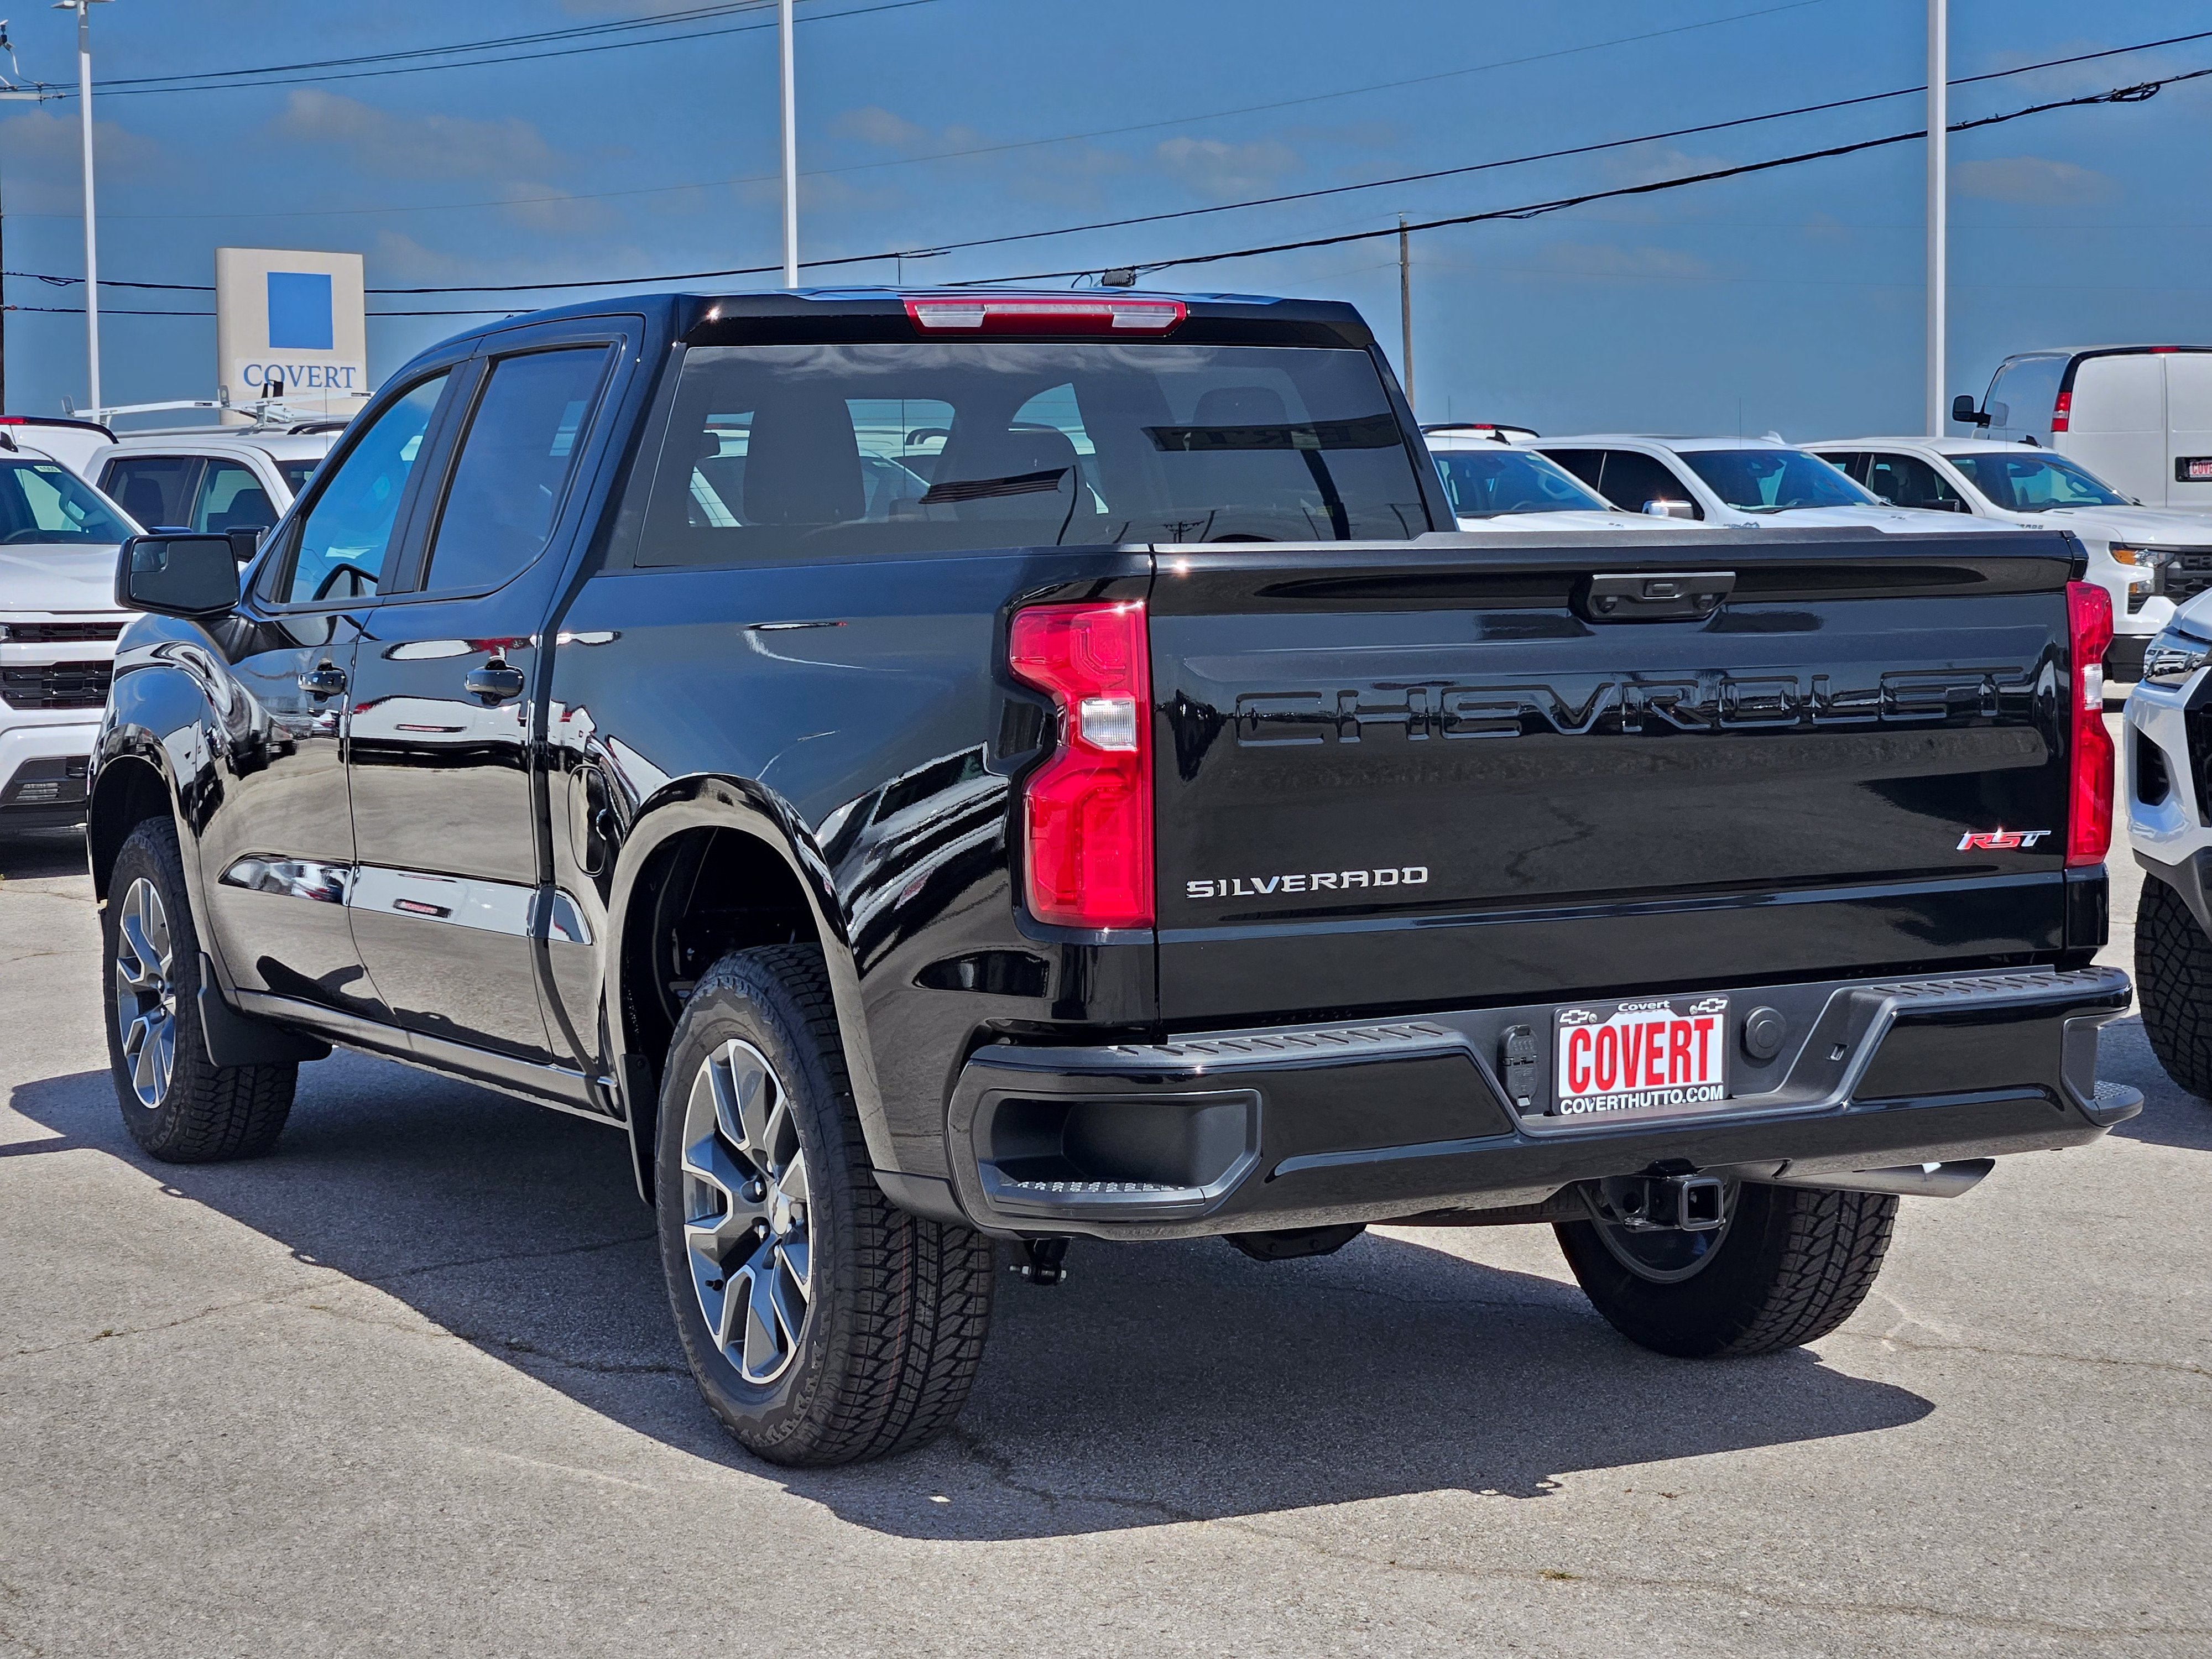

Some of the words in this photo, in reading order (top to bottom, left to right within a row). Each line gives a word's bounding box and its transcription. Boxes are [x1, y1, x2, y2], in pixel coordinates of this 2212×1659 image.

[243, 364, 356, 388] COVERT
[1236, 667, 2024, 747] CHEVROLET
[1956, 830, 2051, 849] RST
[1186, 867, 1428, 898] SILVERADO
[1618, 1000, 1670, 1011] Covert
[1568, 1018, 1714, 1094] COVERT
[1560, 1085, 1724, 1115] COVERTHUTTO.COM
